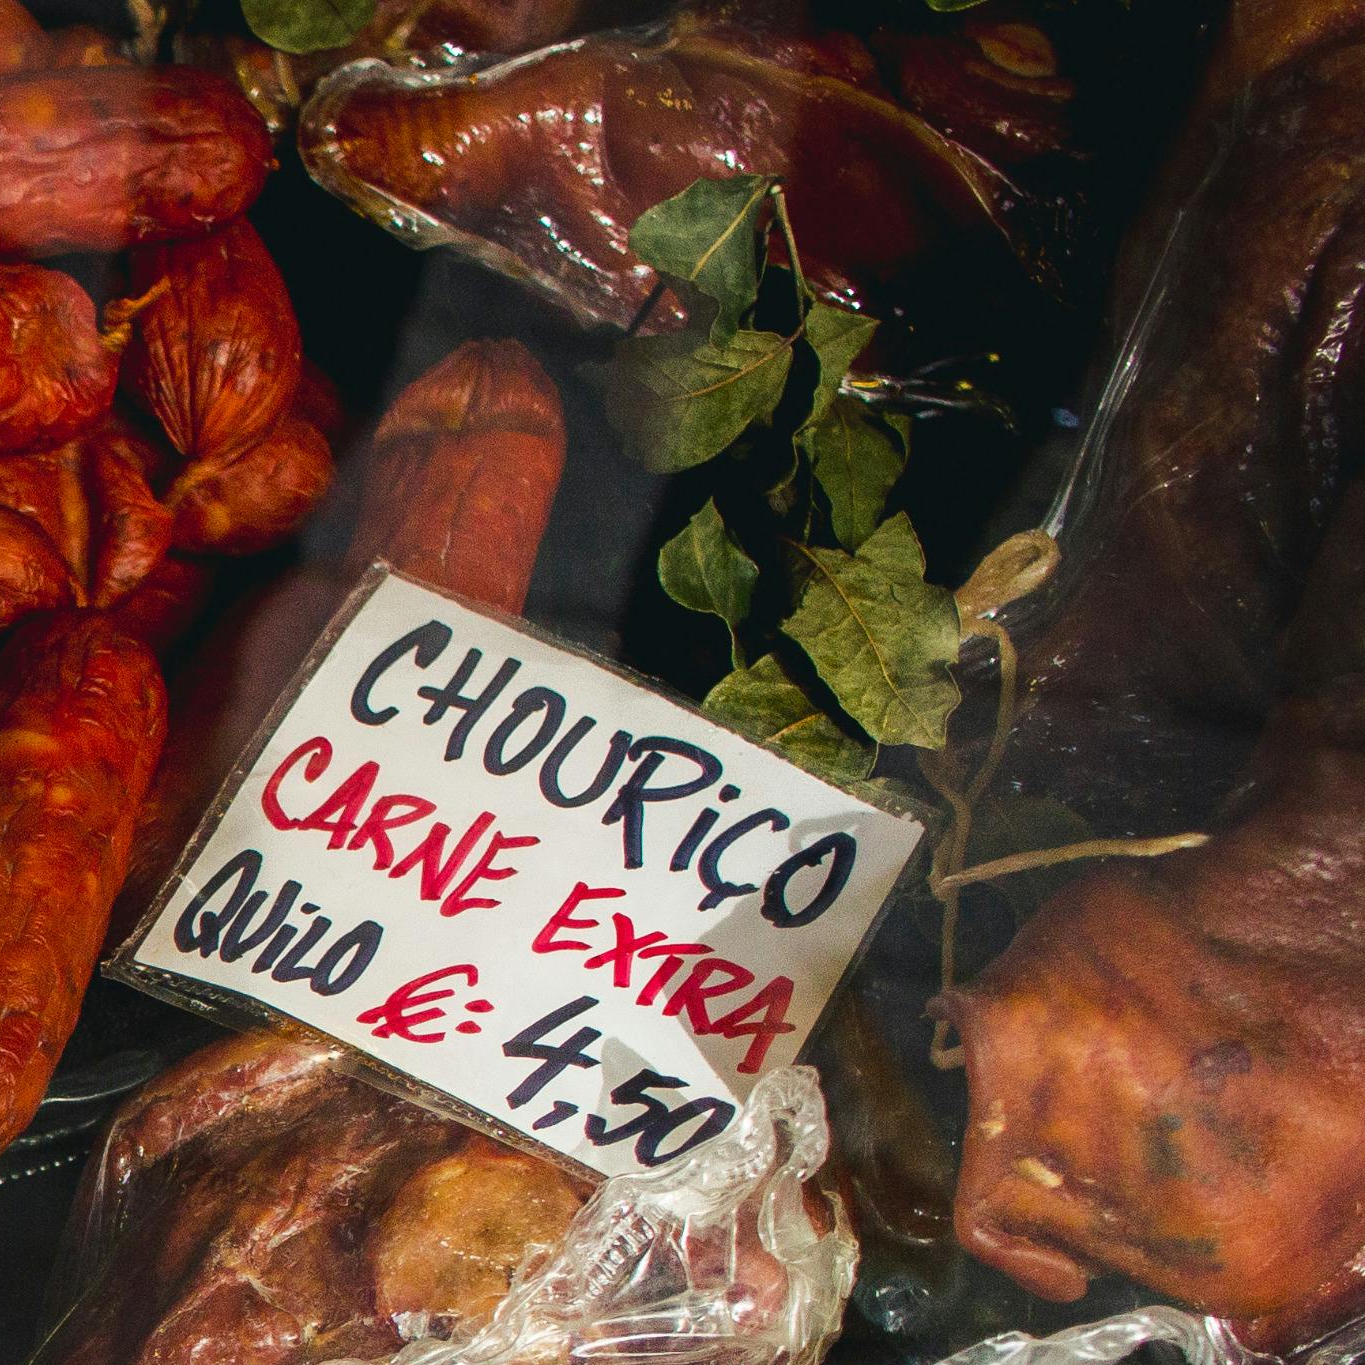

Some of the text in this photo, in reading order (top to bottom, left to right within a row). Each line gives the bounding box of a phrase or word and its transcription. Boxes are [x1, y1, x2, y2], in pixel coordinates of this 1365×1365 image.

[261, 737, 794, 1074] CARNE EXTRA
[503, 996, 736, 1167] 4,50
